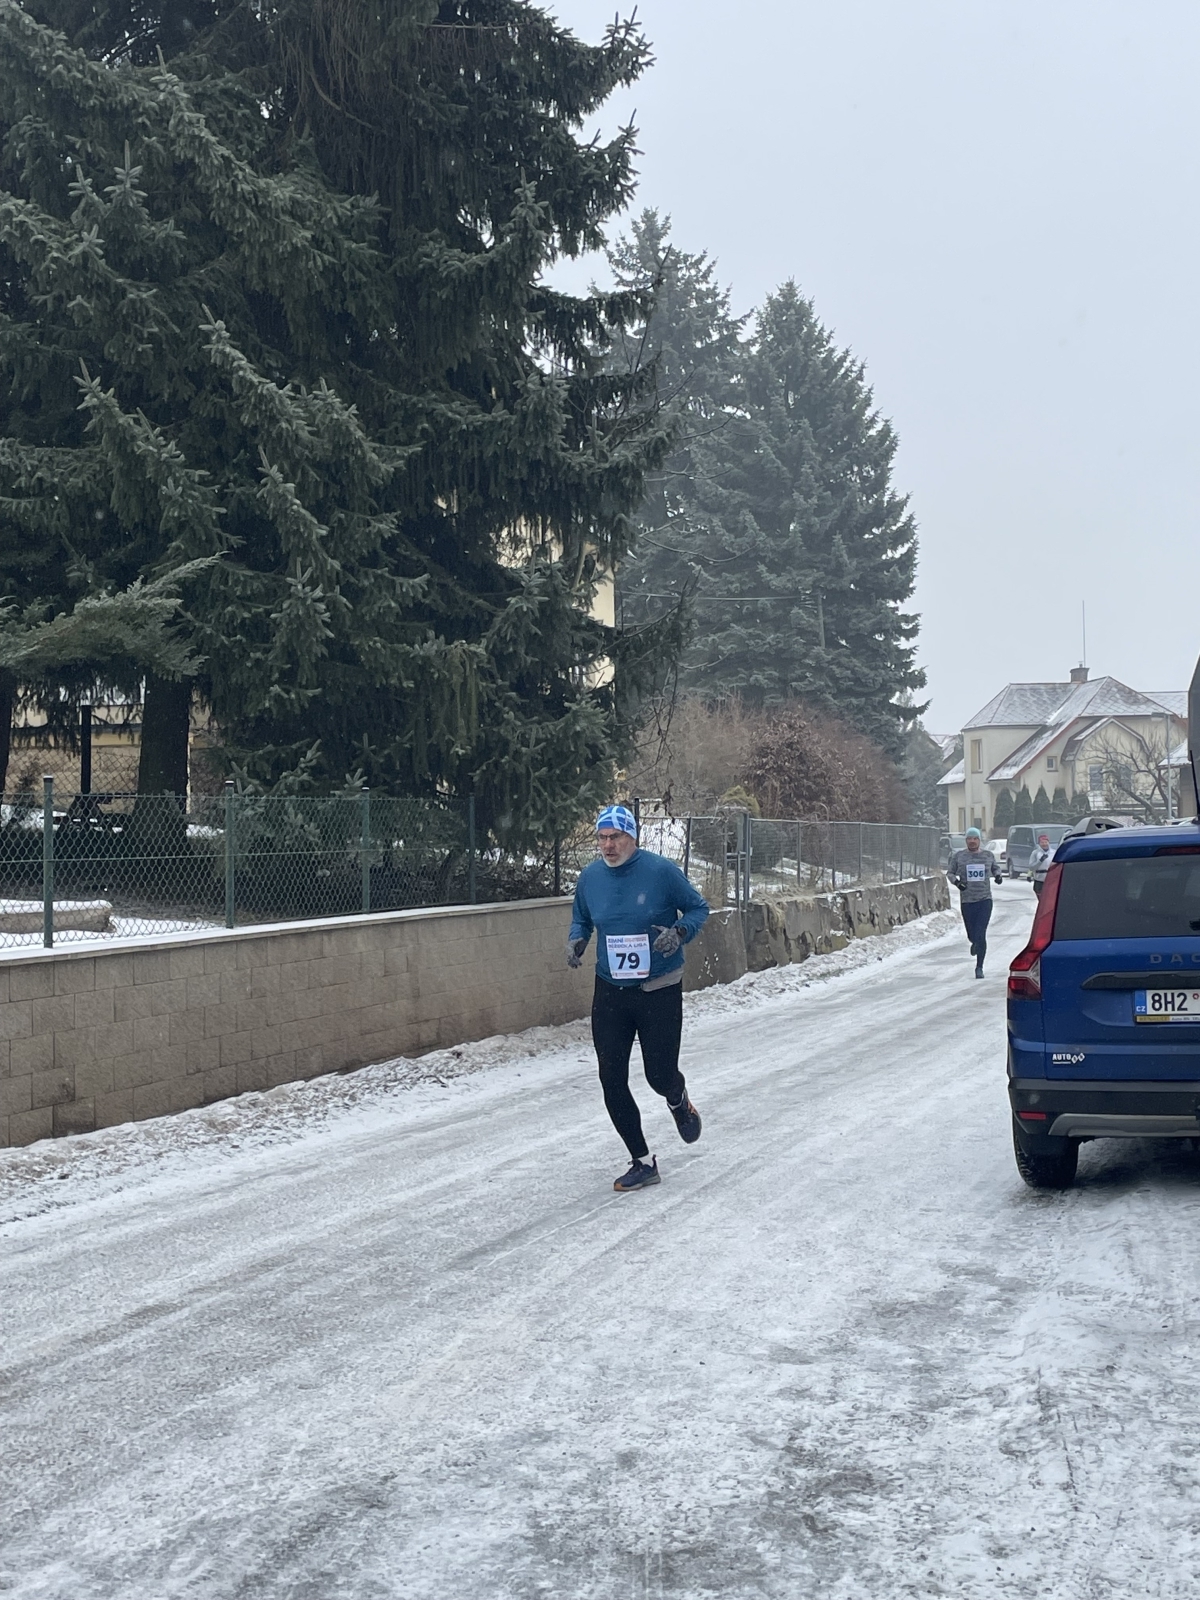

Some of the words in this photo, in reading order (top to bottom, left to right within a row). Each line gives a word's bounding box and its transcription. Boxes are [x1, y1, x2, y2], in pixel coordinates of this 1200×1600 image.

[615, 952, 640, 970] 79
[1151, 992, 1188, 1012] 8H2
[1052, 1053, 1072, 1061] AUTO
